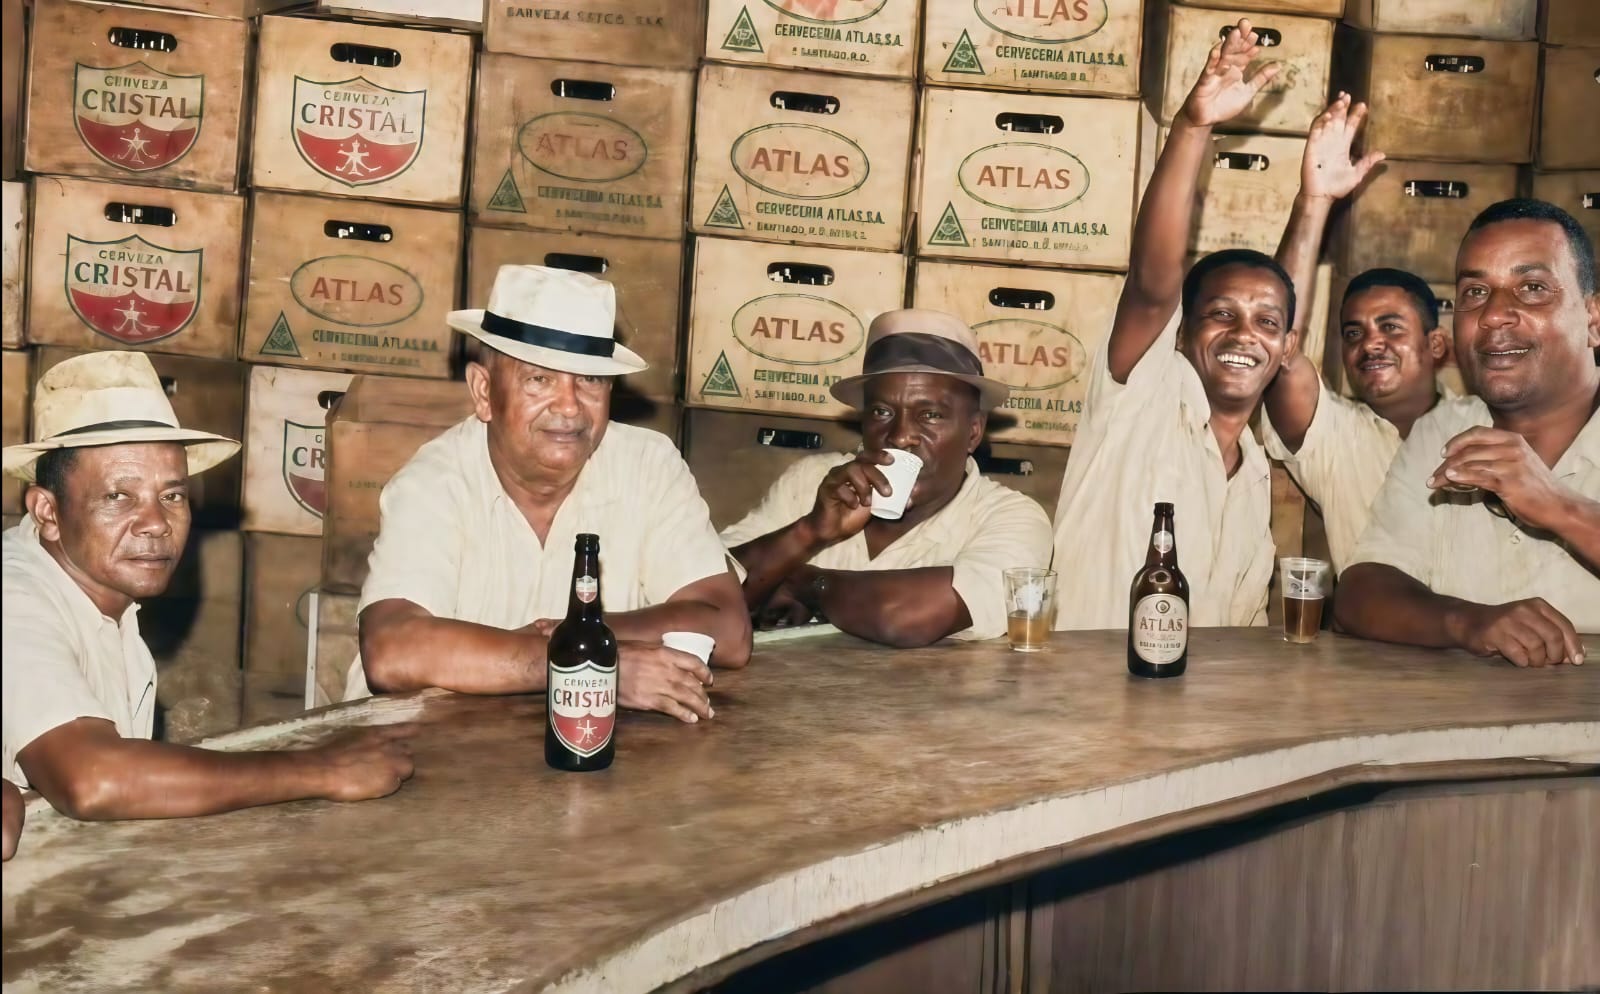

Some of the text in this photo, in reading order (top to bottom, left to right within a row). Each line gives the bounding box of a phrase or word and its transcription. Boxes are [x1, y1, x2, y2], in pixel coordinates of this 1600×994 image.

[775, 23, 842, 42] CERVECERIA
[995, 45, 1064, 63] CERVECERIA
[104, 75, 168, 90] CERVEZA
[82, 88, 197, 119] CRISTAL
[323, 90, 390, 106] CERVEZA
[301, 102, 414, 134] CRISTAL
[535, 133, 629, 161] ATLAS
[750, 147, 850, 178] ATLAS
[976, 165, 1071, 190] ATLAS
[756, 201, 823, 219] CERVECERIA
[981, 217, 1048, 233] CERVECERIA
[98, 249, 164, 265] CERVEZA
[74, 262, 191, 293] CRISTAL
[310, 276, 404, 306] ATLAS
[750, 316, 845, 344] ATLAS
[978, 341, 1069, 368] ATLAS
[753, 369, 819, 386] CERVECERIA
[1139, 616, 1183, 632] ATLAS
[553, 688, 615, 708] CRISTAL
